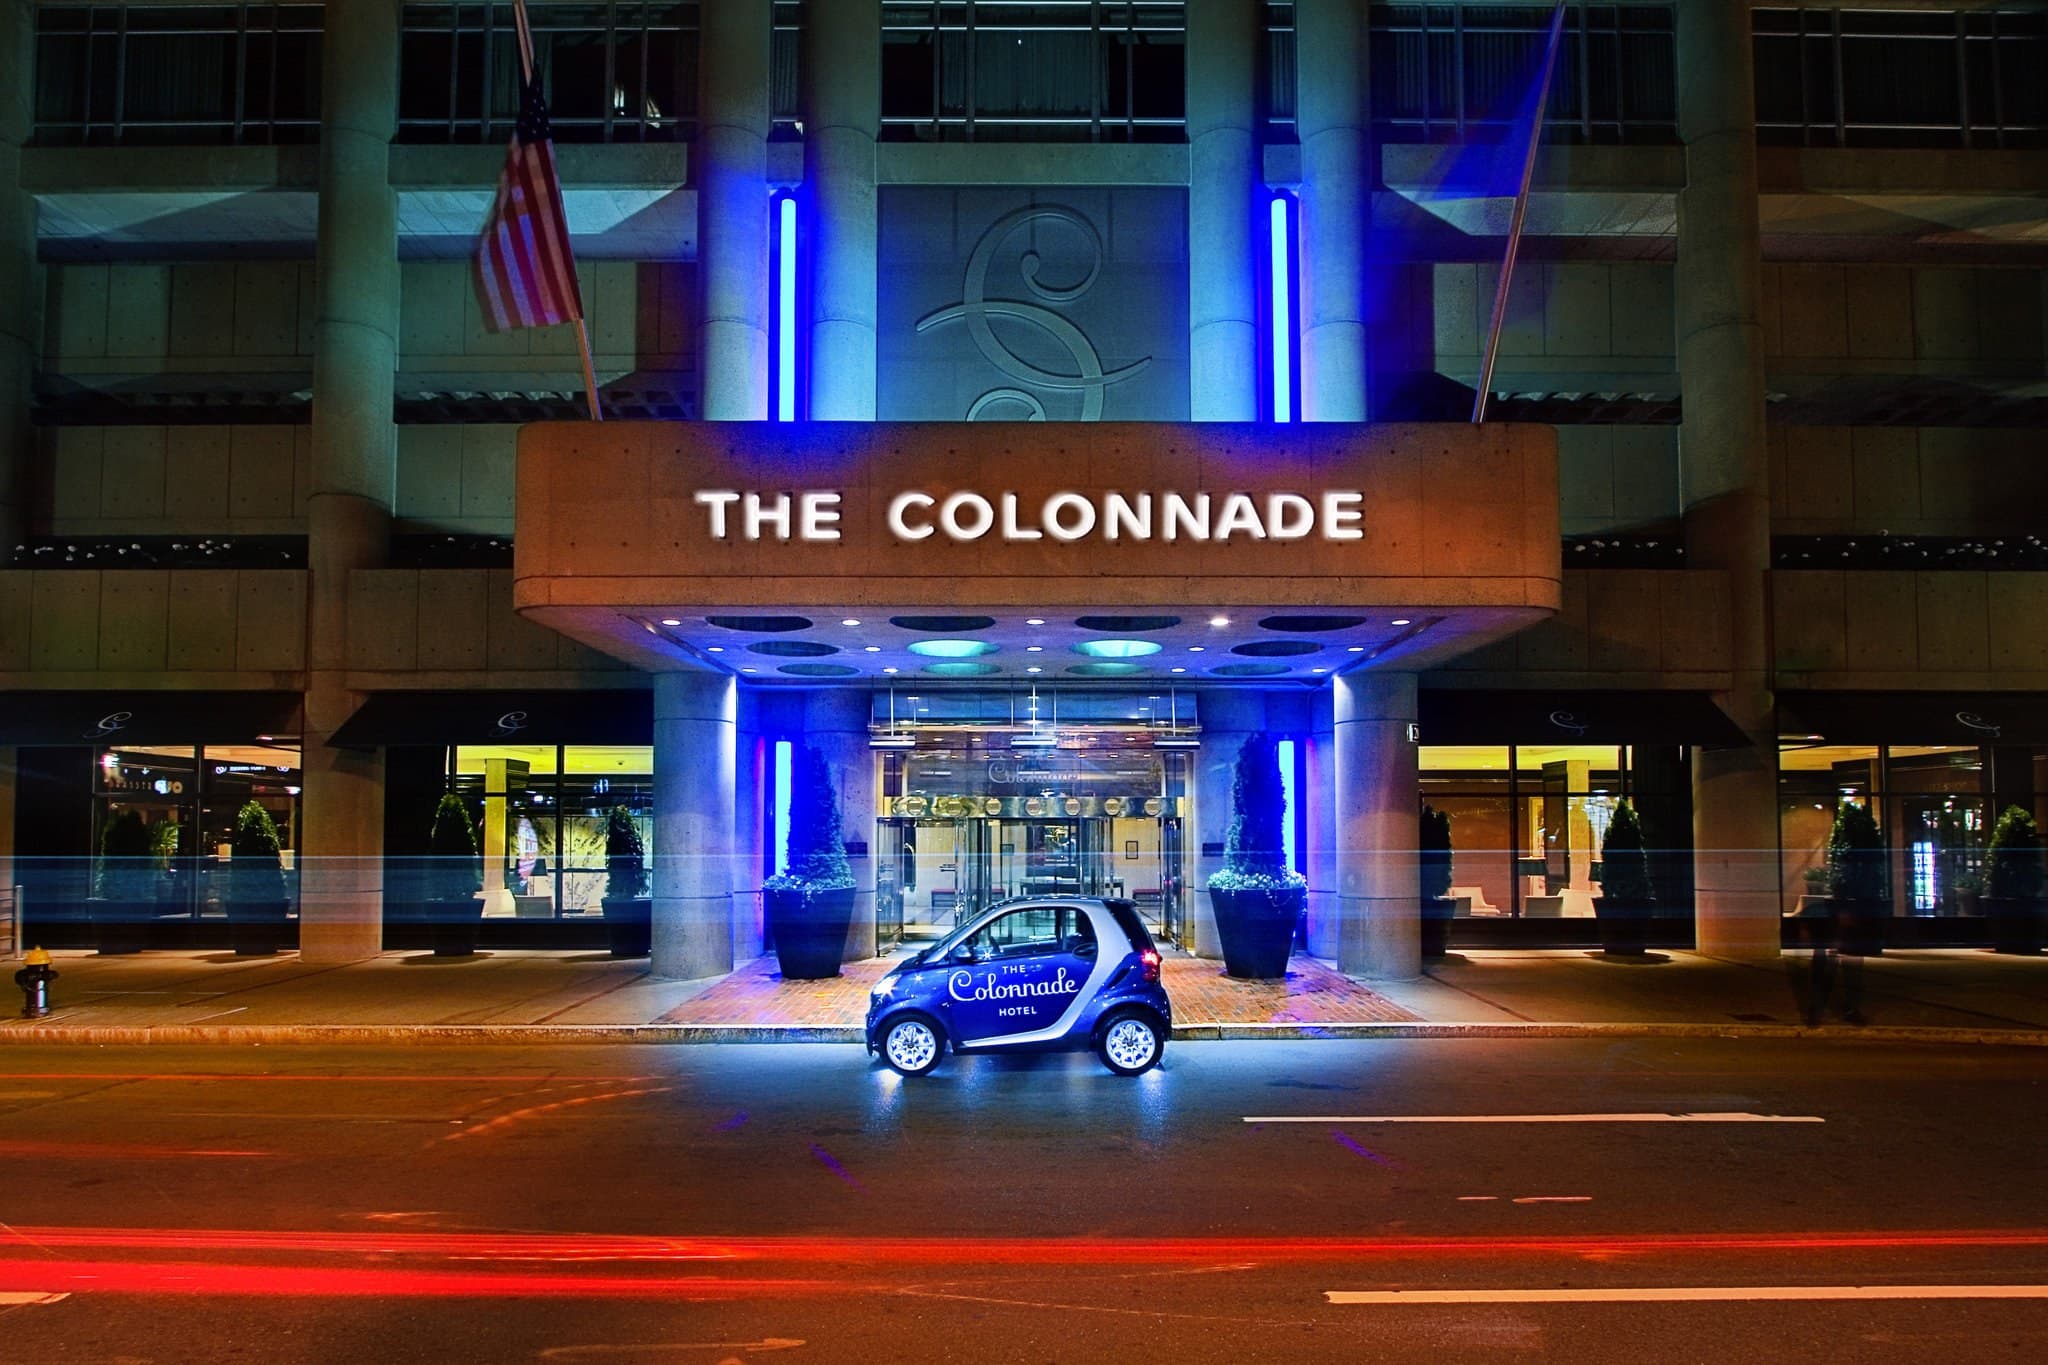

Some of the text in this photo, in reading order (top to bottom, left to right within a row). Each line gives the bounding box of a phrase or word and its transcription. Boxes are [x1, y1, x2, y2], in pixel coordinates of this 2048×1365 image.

[695, 491, 1365, 540] THE COLONNADE
[988, 761, 1079, 784] Colon
[1002, 964, 1026, 975] THE
[948, 967, 1079, 1002] Colonnade
[998, 1005, 1038, 1017] HOTEL
